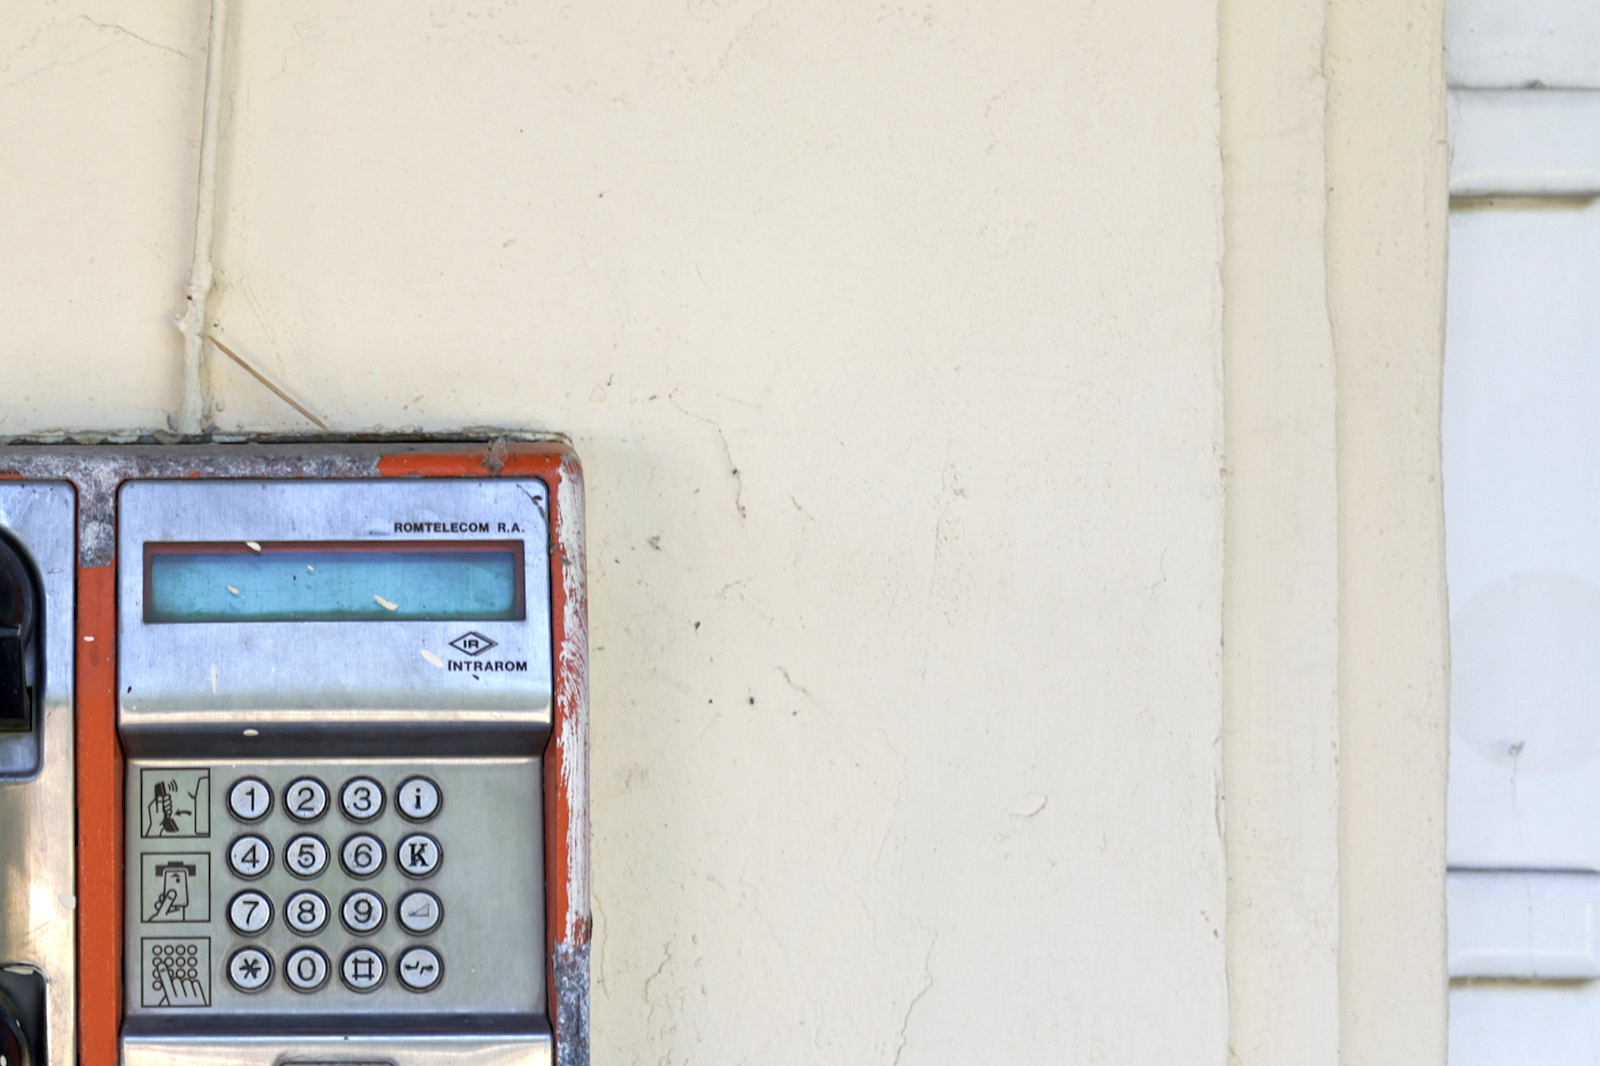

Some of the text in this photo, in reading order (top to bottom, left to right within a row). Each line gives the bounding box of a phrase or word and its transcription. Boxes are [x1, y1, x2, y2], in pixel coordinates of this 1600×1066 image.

[393, 522, 525, 533] ROMTELECOM R.A.
[463, 639, 479, 649] IR
[447, 660, 528, 672] INTRAROM
[245, 786, 423, 812] 1 2 3 i
[240, 843, 428, 869] 4 5 6 K
[242, 898, 373, 926] 7 8 9
[297, 956, 317, 982] 0
